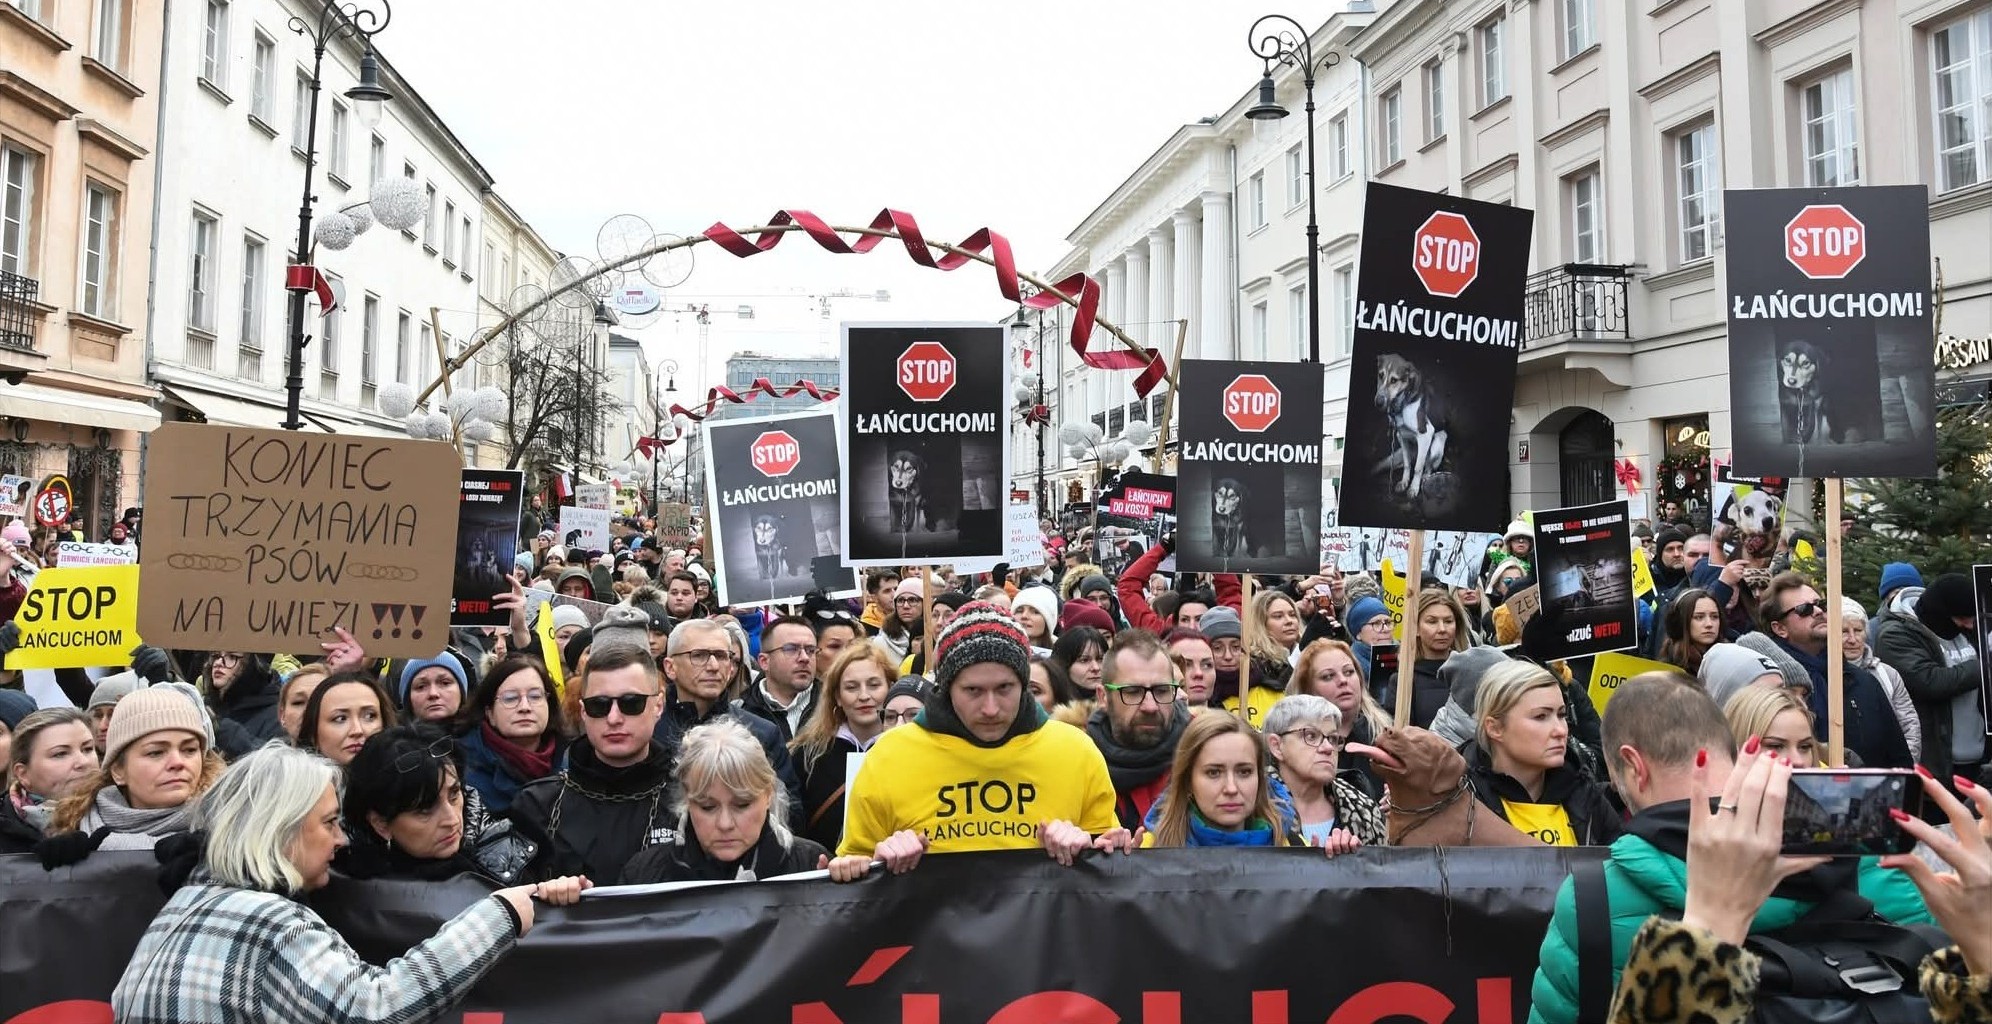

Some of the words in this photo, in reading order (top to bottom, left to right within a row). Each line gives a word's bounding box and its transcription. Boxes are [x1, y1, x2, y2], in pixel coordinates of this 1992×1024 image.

[1419, 234, 1475, 273] STOP
[1792, 227, 1858, 257] STOP
[1733, 290, 1923, 319] ŁAŃCUCHOM!
[1356, 300, 1518, 348] ŁAŃCUCHOM!
[902, 359, 951, 383] STOP
[1228, 391, 1277, 415] STOP
[856, 409, 996, 433] ŁAŃCUCHOM!
[224, 432, 391, 491] KONIEC
[755, 443, 796, 464] STOP
[1183, 438, 1319, 464] ŁAŃCUCHOM!
[722, 479, 837, 506] ŁAŃCUCHOM!
[1128, 490, 1168, 505] ŁAŃCUCHY
[171, 492, 417, 546] TRZYMANIA
[1113, 502, 1123, 513] DO
[1125, 503, 1149, 516] KOSZA
[245, 540, 347, 585] PSÓW
[23, 586, 116, 622] STOP
[173, 596, 223, 632] NA
[459, 600, 489, 614] WETO!
[17, 627, 122, 649] AŃCUCHOM
[1594, 621, 1621, 638] WETO!
[936, 780, 1036, 817] STOP
